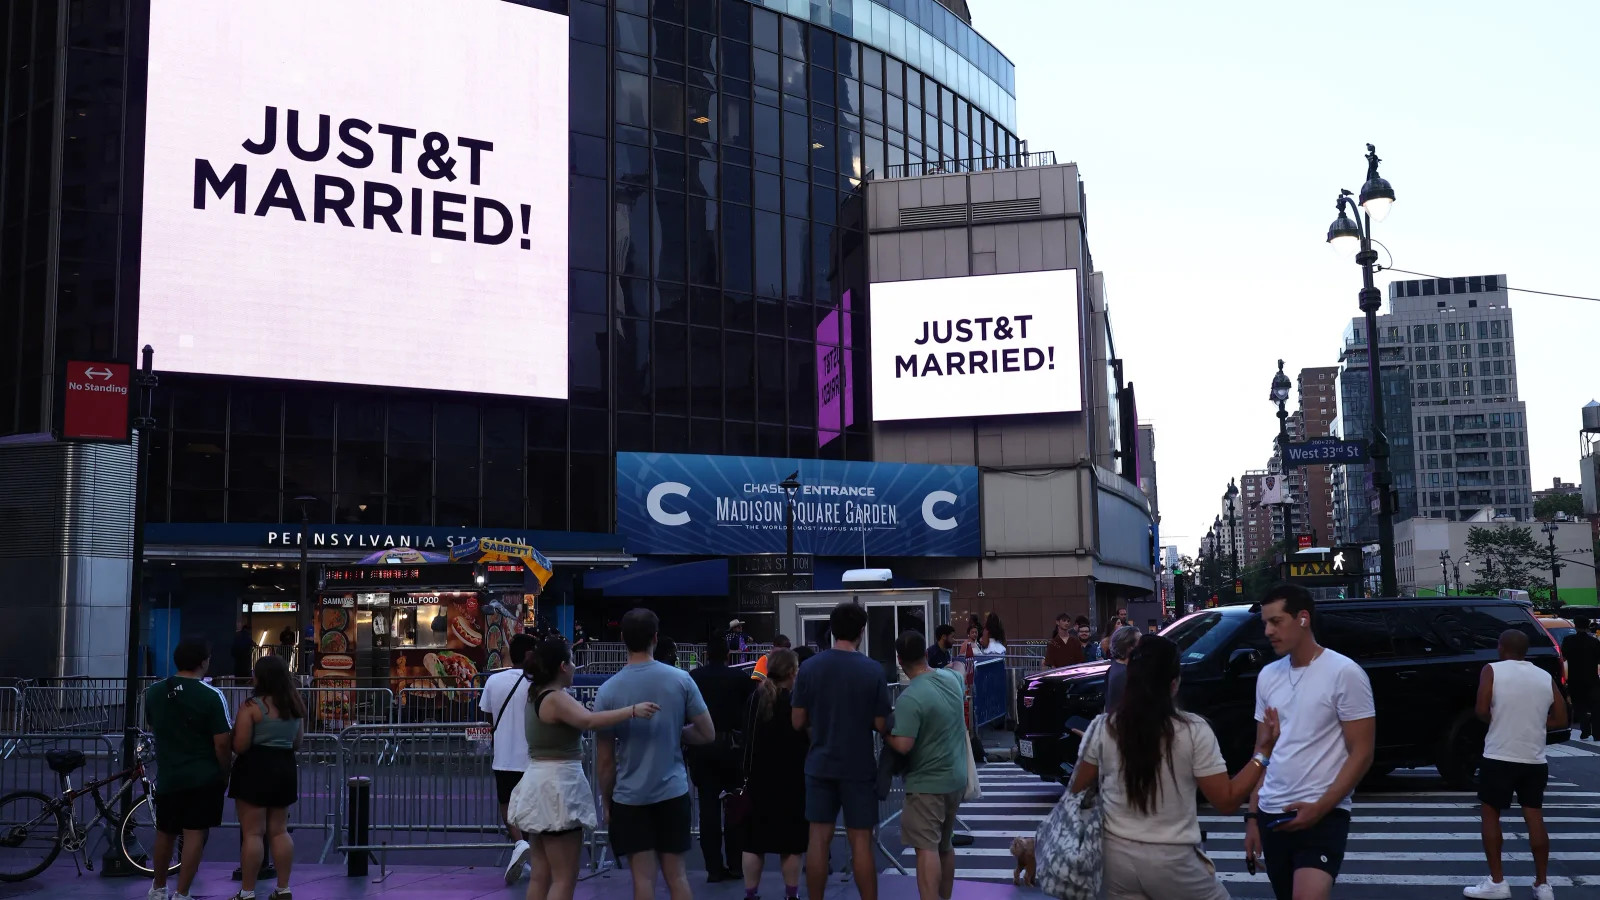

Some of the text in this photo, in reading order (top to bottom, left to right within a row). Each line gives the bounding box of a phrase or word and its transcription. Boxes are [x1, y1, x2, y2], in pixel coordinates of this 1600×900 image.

[241, 105, 494, 186] JUST&T
[193, 158, 532, 251] MARRIED!
[914, 314, 1033, 345] JUST&T
[895, 346, 1055, 379] MARRIED!
[68, 381, 128, 395] No Standing
[1288, 445, 1360, 460] West 33rd St
[743, 483, 876, 497] CHASE ENTRANCE
[646, 481, 692, 526] C
[716, 496, 783, 522] MADISON
[921, 490, 959, 531] C
[482, 541, 530, 555] SABRETT
[775, 557, 809, 571] STTION
[1292, 563, 1330, 576] TAX
[418, 596, 439, 604] FOOD
